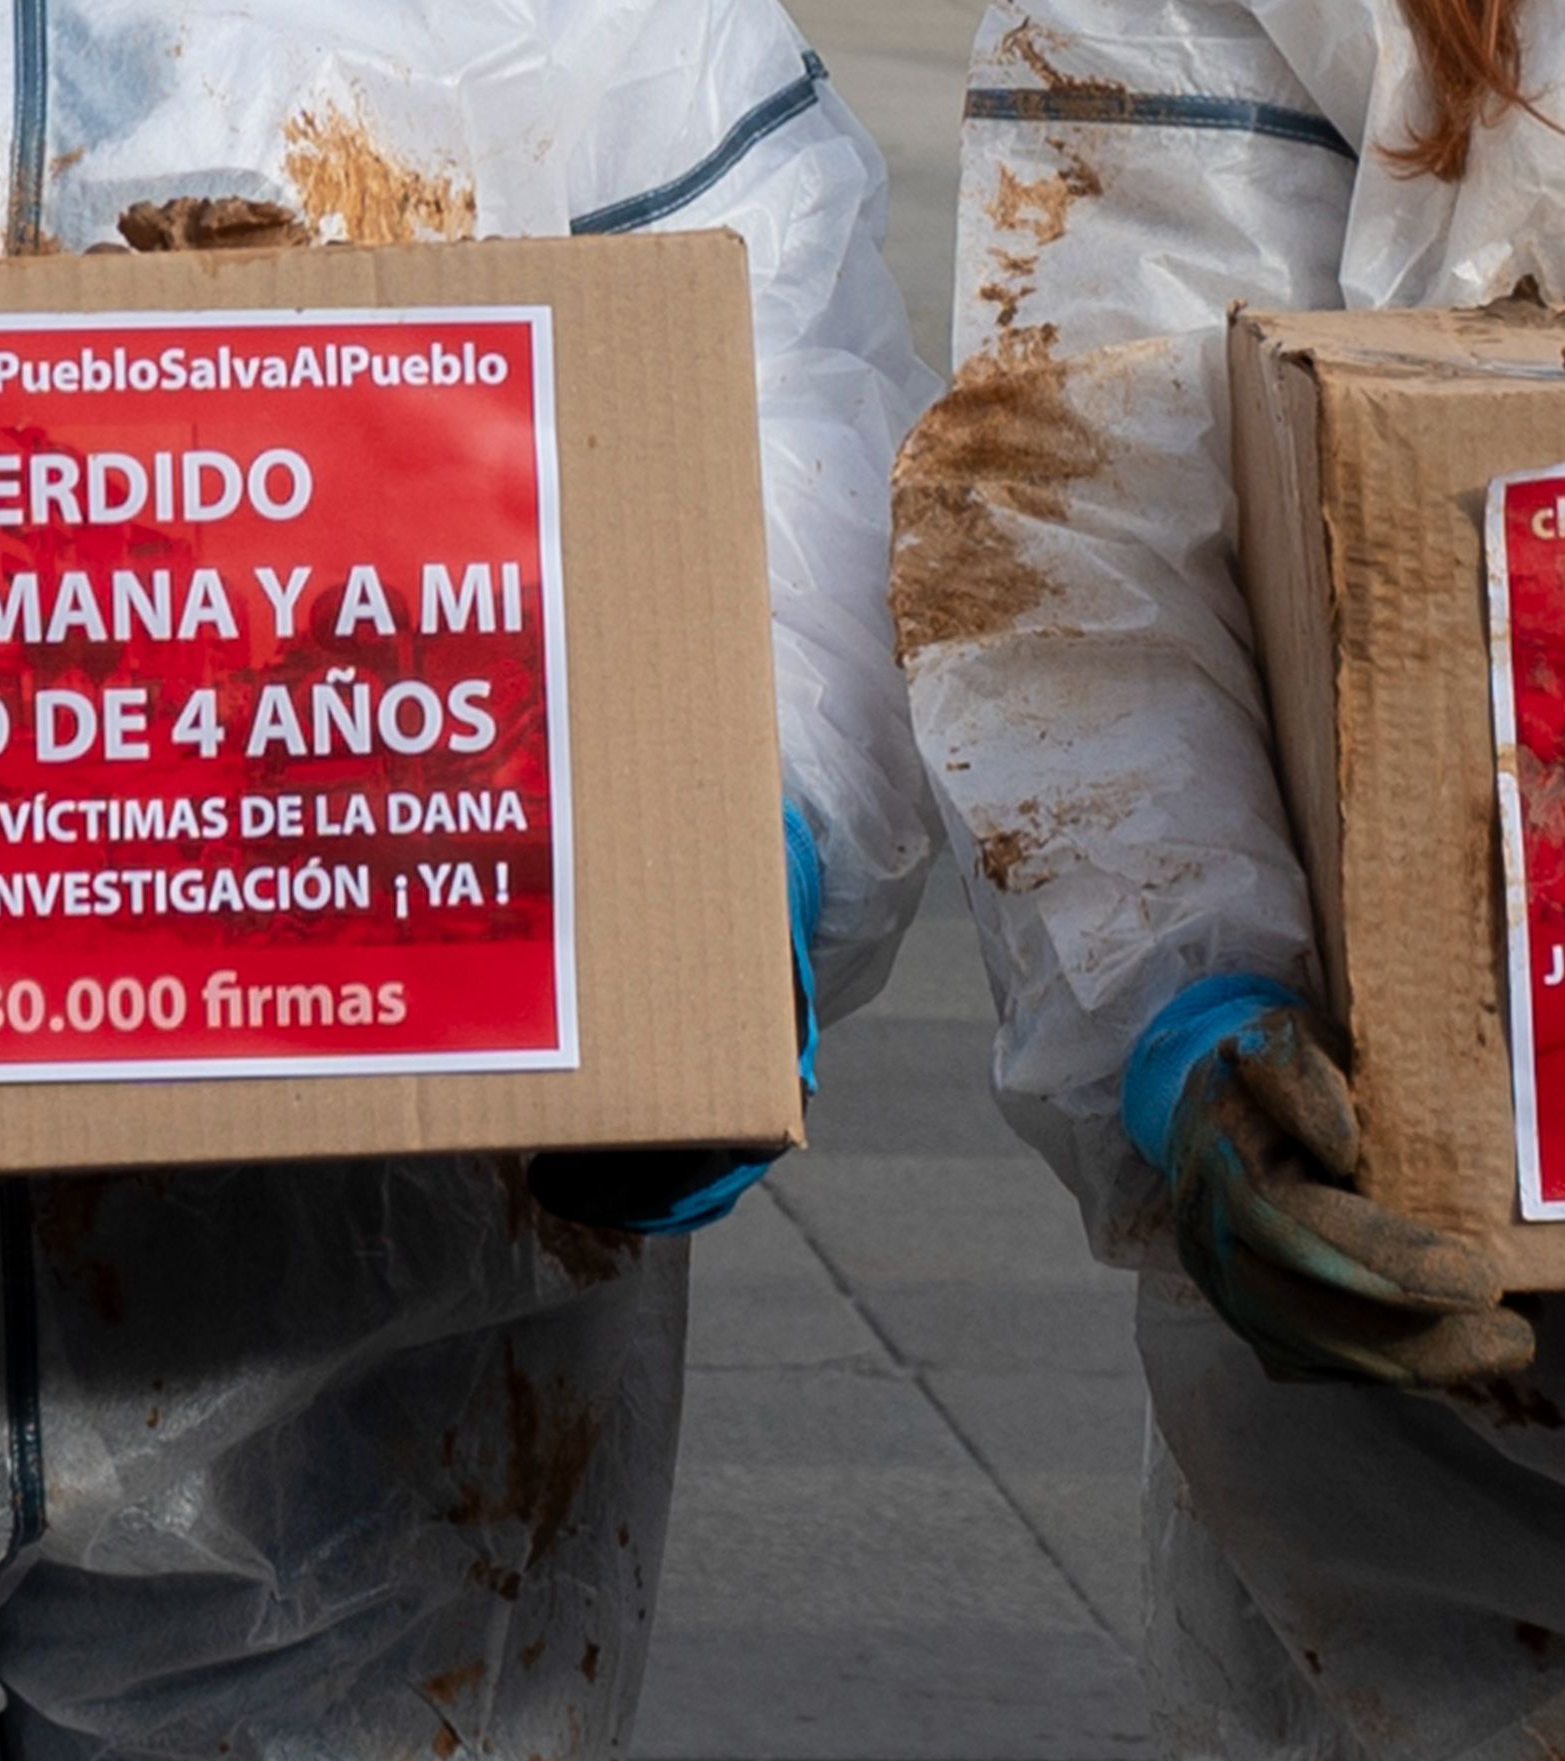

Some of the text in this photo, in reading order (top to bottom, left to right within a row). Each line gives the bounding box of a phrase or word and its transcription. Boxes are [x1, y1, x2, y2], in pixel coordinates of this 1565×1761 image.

[253, 565, 313, 638] Y
[335, 564, 396, 636] A
[421, 561, 522, 634] MI
[35, 687, 150, 762] DE
[171, 688, 225, 758] 4
[246, 666, 497, 757] AÑOS
[240, 795, 304, 838] DE
[315, 793, 376, 836] LA
[388, 790, 528, 834] DANA
[201, 969, 407, 1029] firmas
